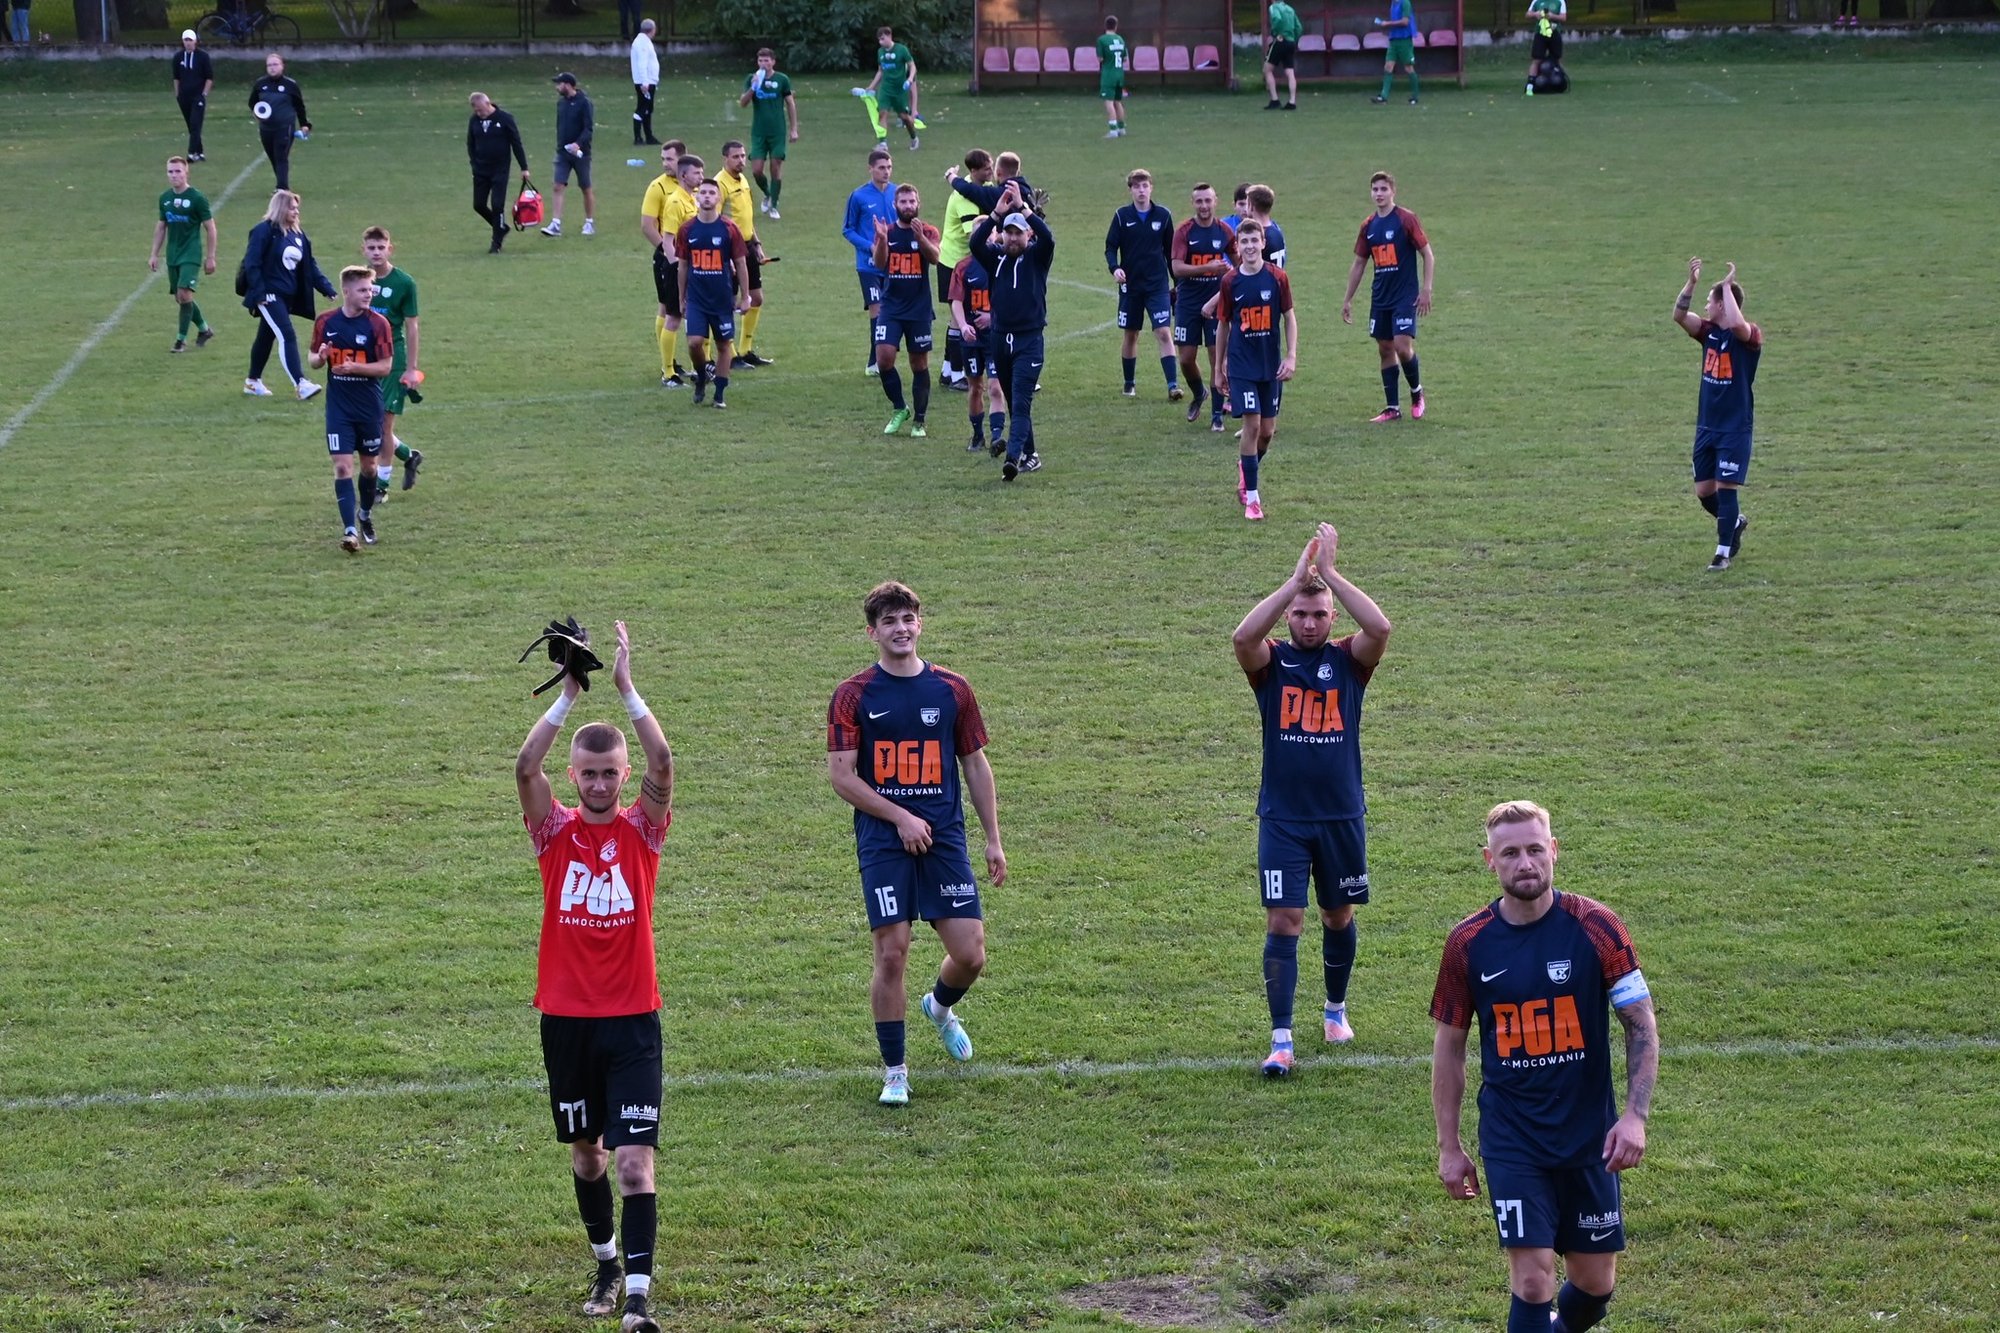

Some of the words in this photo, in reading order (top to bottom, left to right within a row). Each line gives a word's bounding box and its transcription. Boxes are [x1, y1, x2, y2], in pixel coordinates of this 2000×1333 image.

[889, 252, 922, 274] PGA
[869, 287, 880, 301] 14
[875, 325, 887, 341] 29
[1174, 326, 1187, 341] 98
[1243, 391, 1256, 409] 15
[328, 434, 340, 451] 10
[1280, 685, 1344, 733] PGA
[874, 740, 942, 785] PGA
[876, 785, 943, 796] ZAMOCOWANIA
[560, 860, 635, 917] PGA
[1264, 870, 1283, 899] 18
[875, 886, 898, 917] 16
[559, 915, 636, 928] ZAMOCOWANIA
[1492, 995, 1585, 1057] PGA
[559, 1099, 588, 1134] 77
[1495, 1199, 1524, 1238] 27
[1578, 1211, 1619, 1224] Lak-Ma
